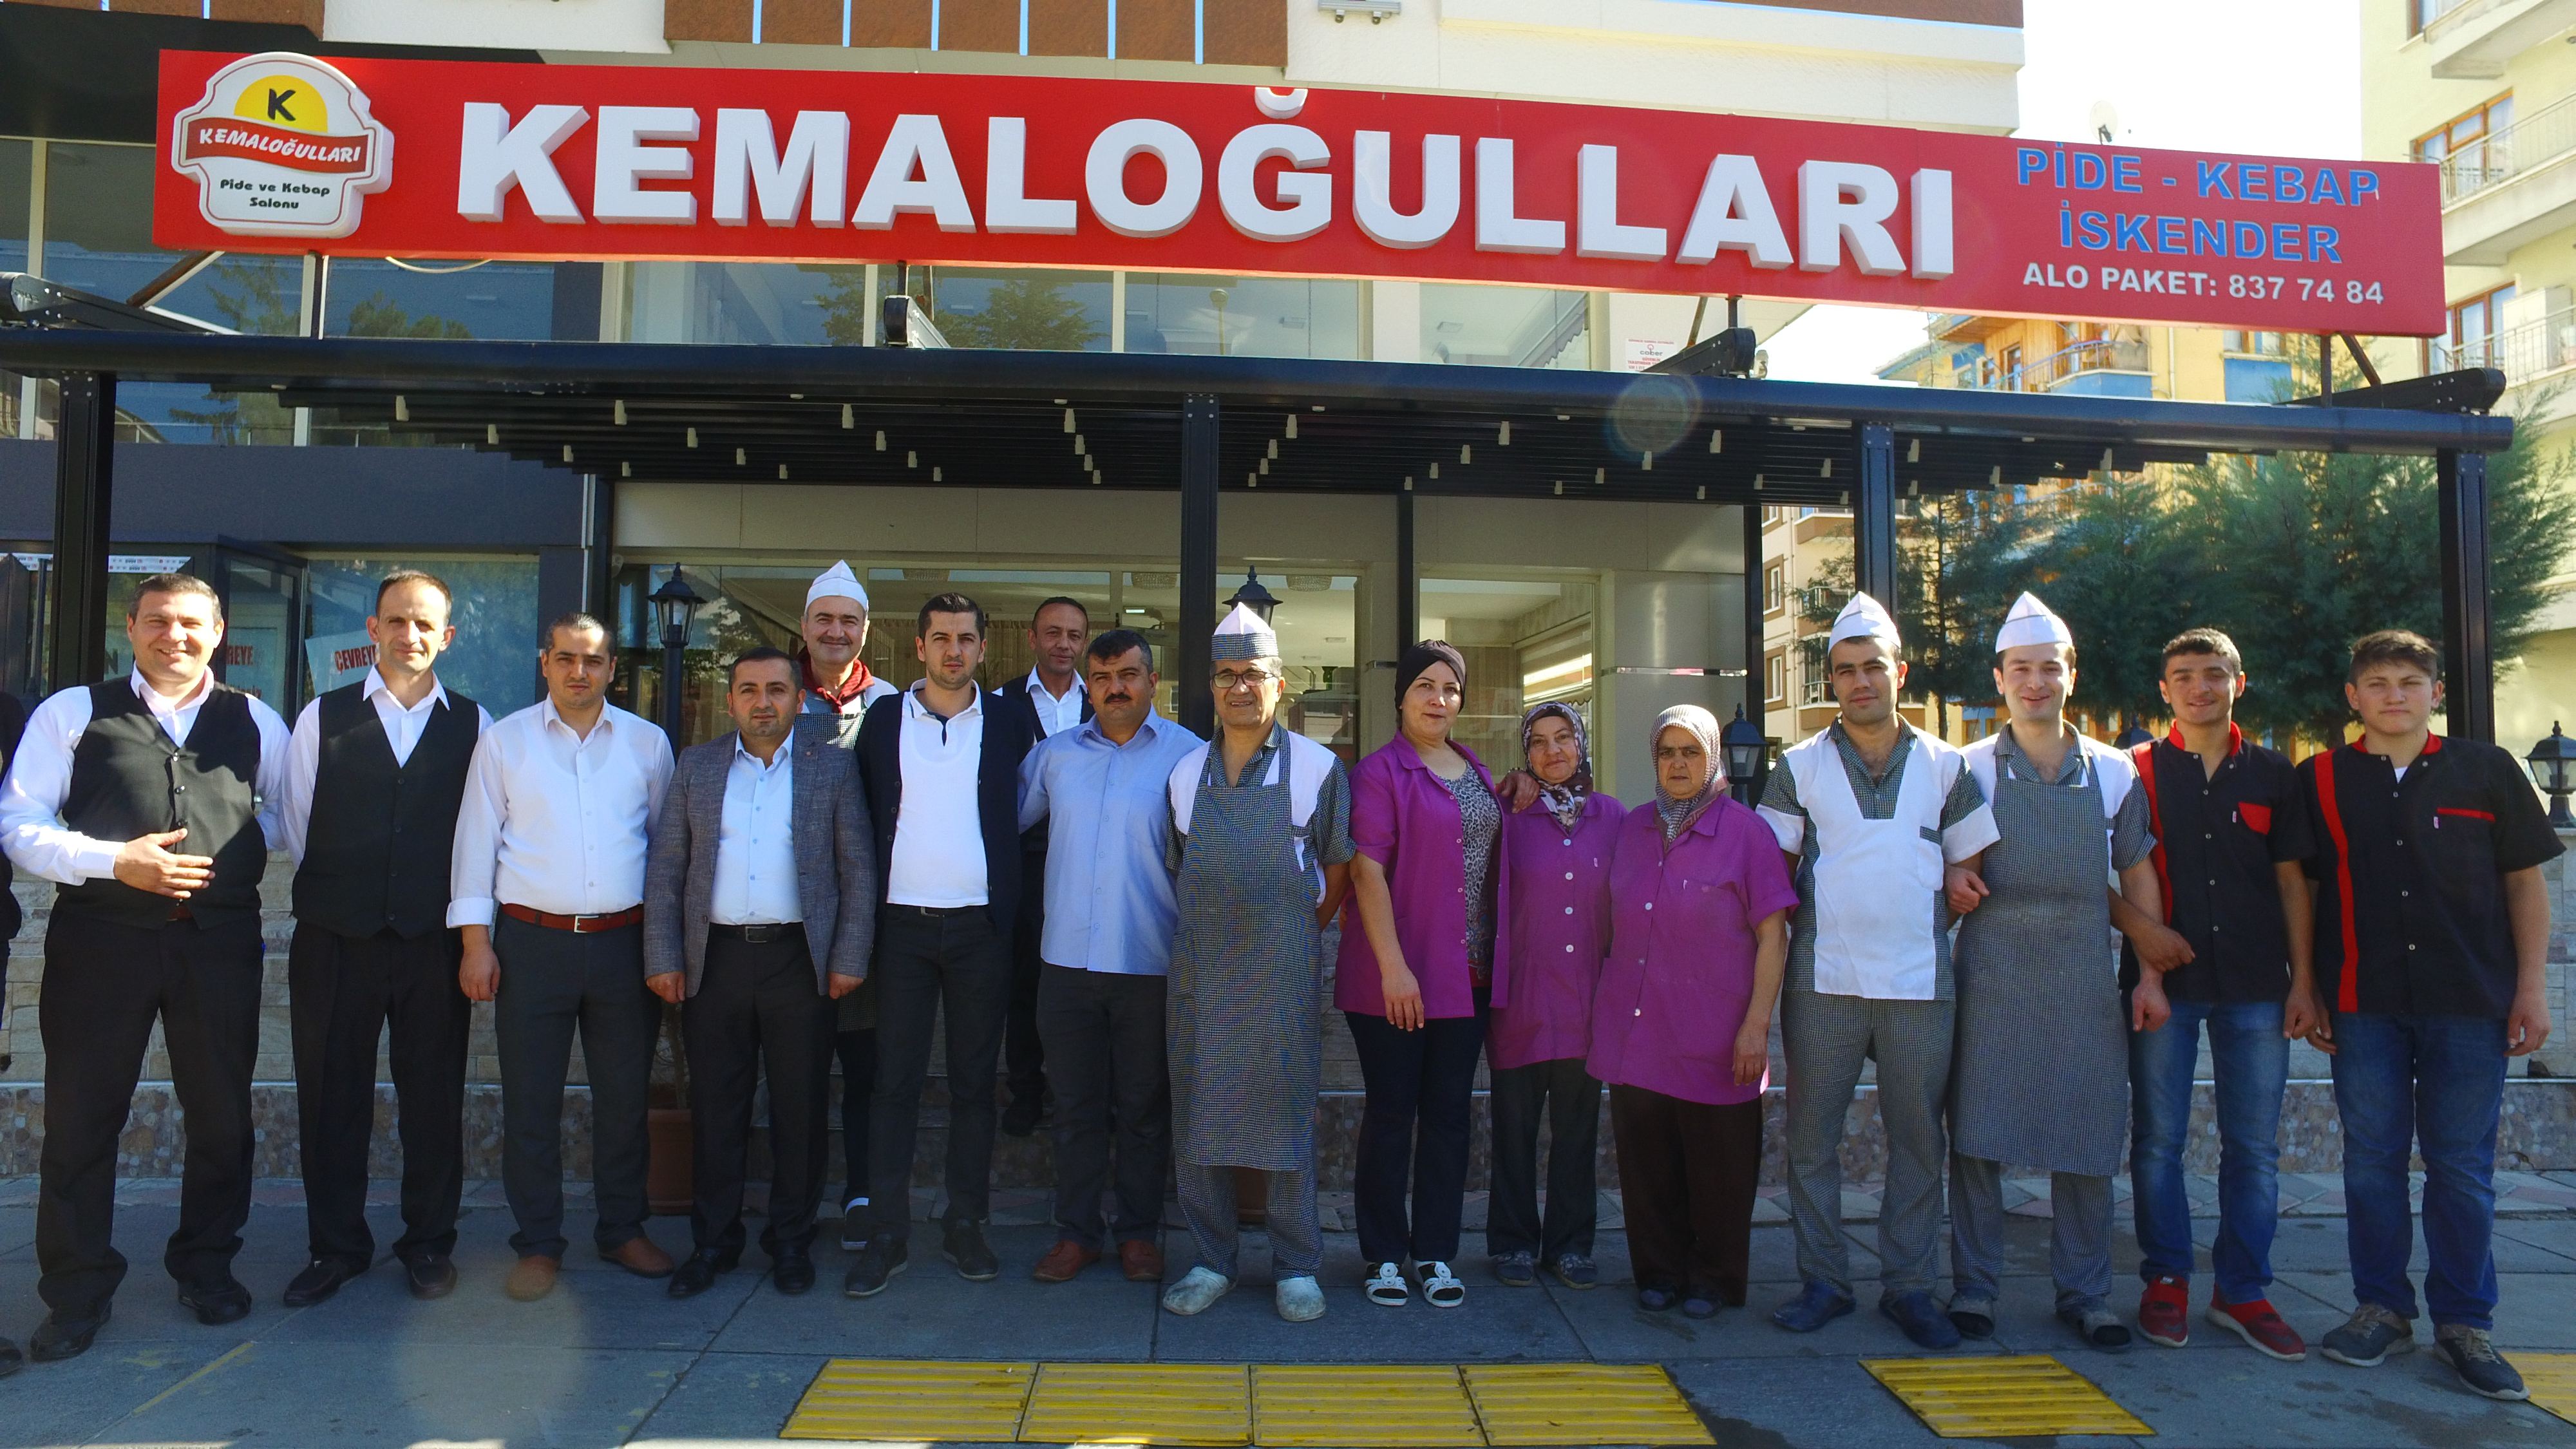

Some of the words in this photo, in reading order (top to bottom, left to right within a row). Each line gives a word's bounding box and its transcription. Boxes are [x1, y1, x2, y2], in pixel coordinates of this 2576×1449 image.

[267, 88, 296, 121] K
[199, 128, 361, 163] KEMALOĞULLARI
[259, 184, 276, 193] ve
[282, 183, 330, 197] Kebap
[458, 87, 1954, 280] KEMALOĞULLARI
[2016, 142, 2143, 193] PİDE
[2196, 160, 2379, 206] KEBAP
[249, 197, 299, 209] Salonu
[2060, 201, 2342, 264] İSKENDER
[2023, 263, 2089, 289] ALO
[2101, 267, 2217, 296] PAKET:
[2229, 275, 2285, 300] 837
[2297, 278, 2335, 303] 74
[2346, 281, 2384, 305] 84
